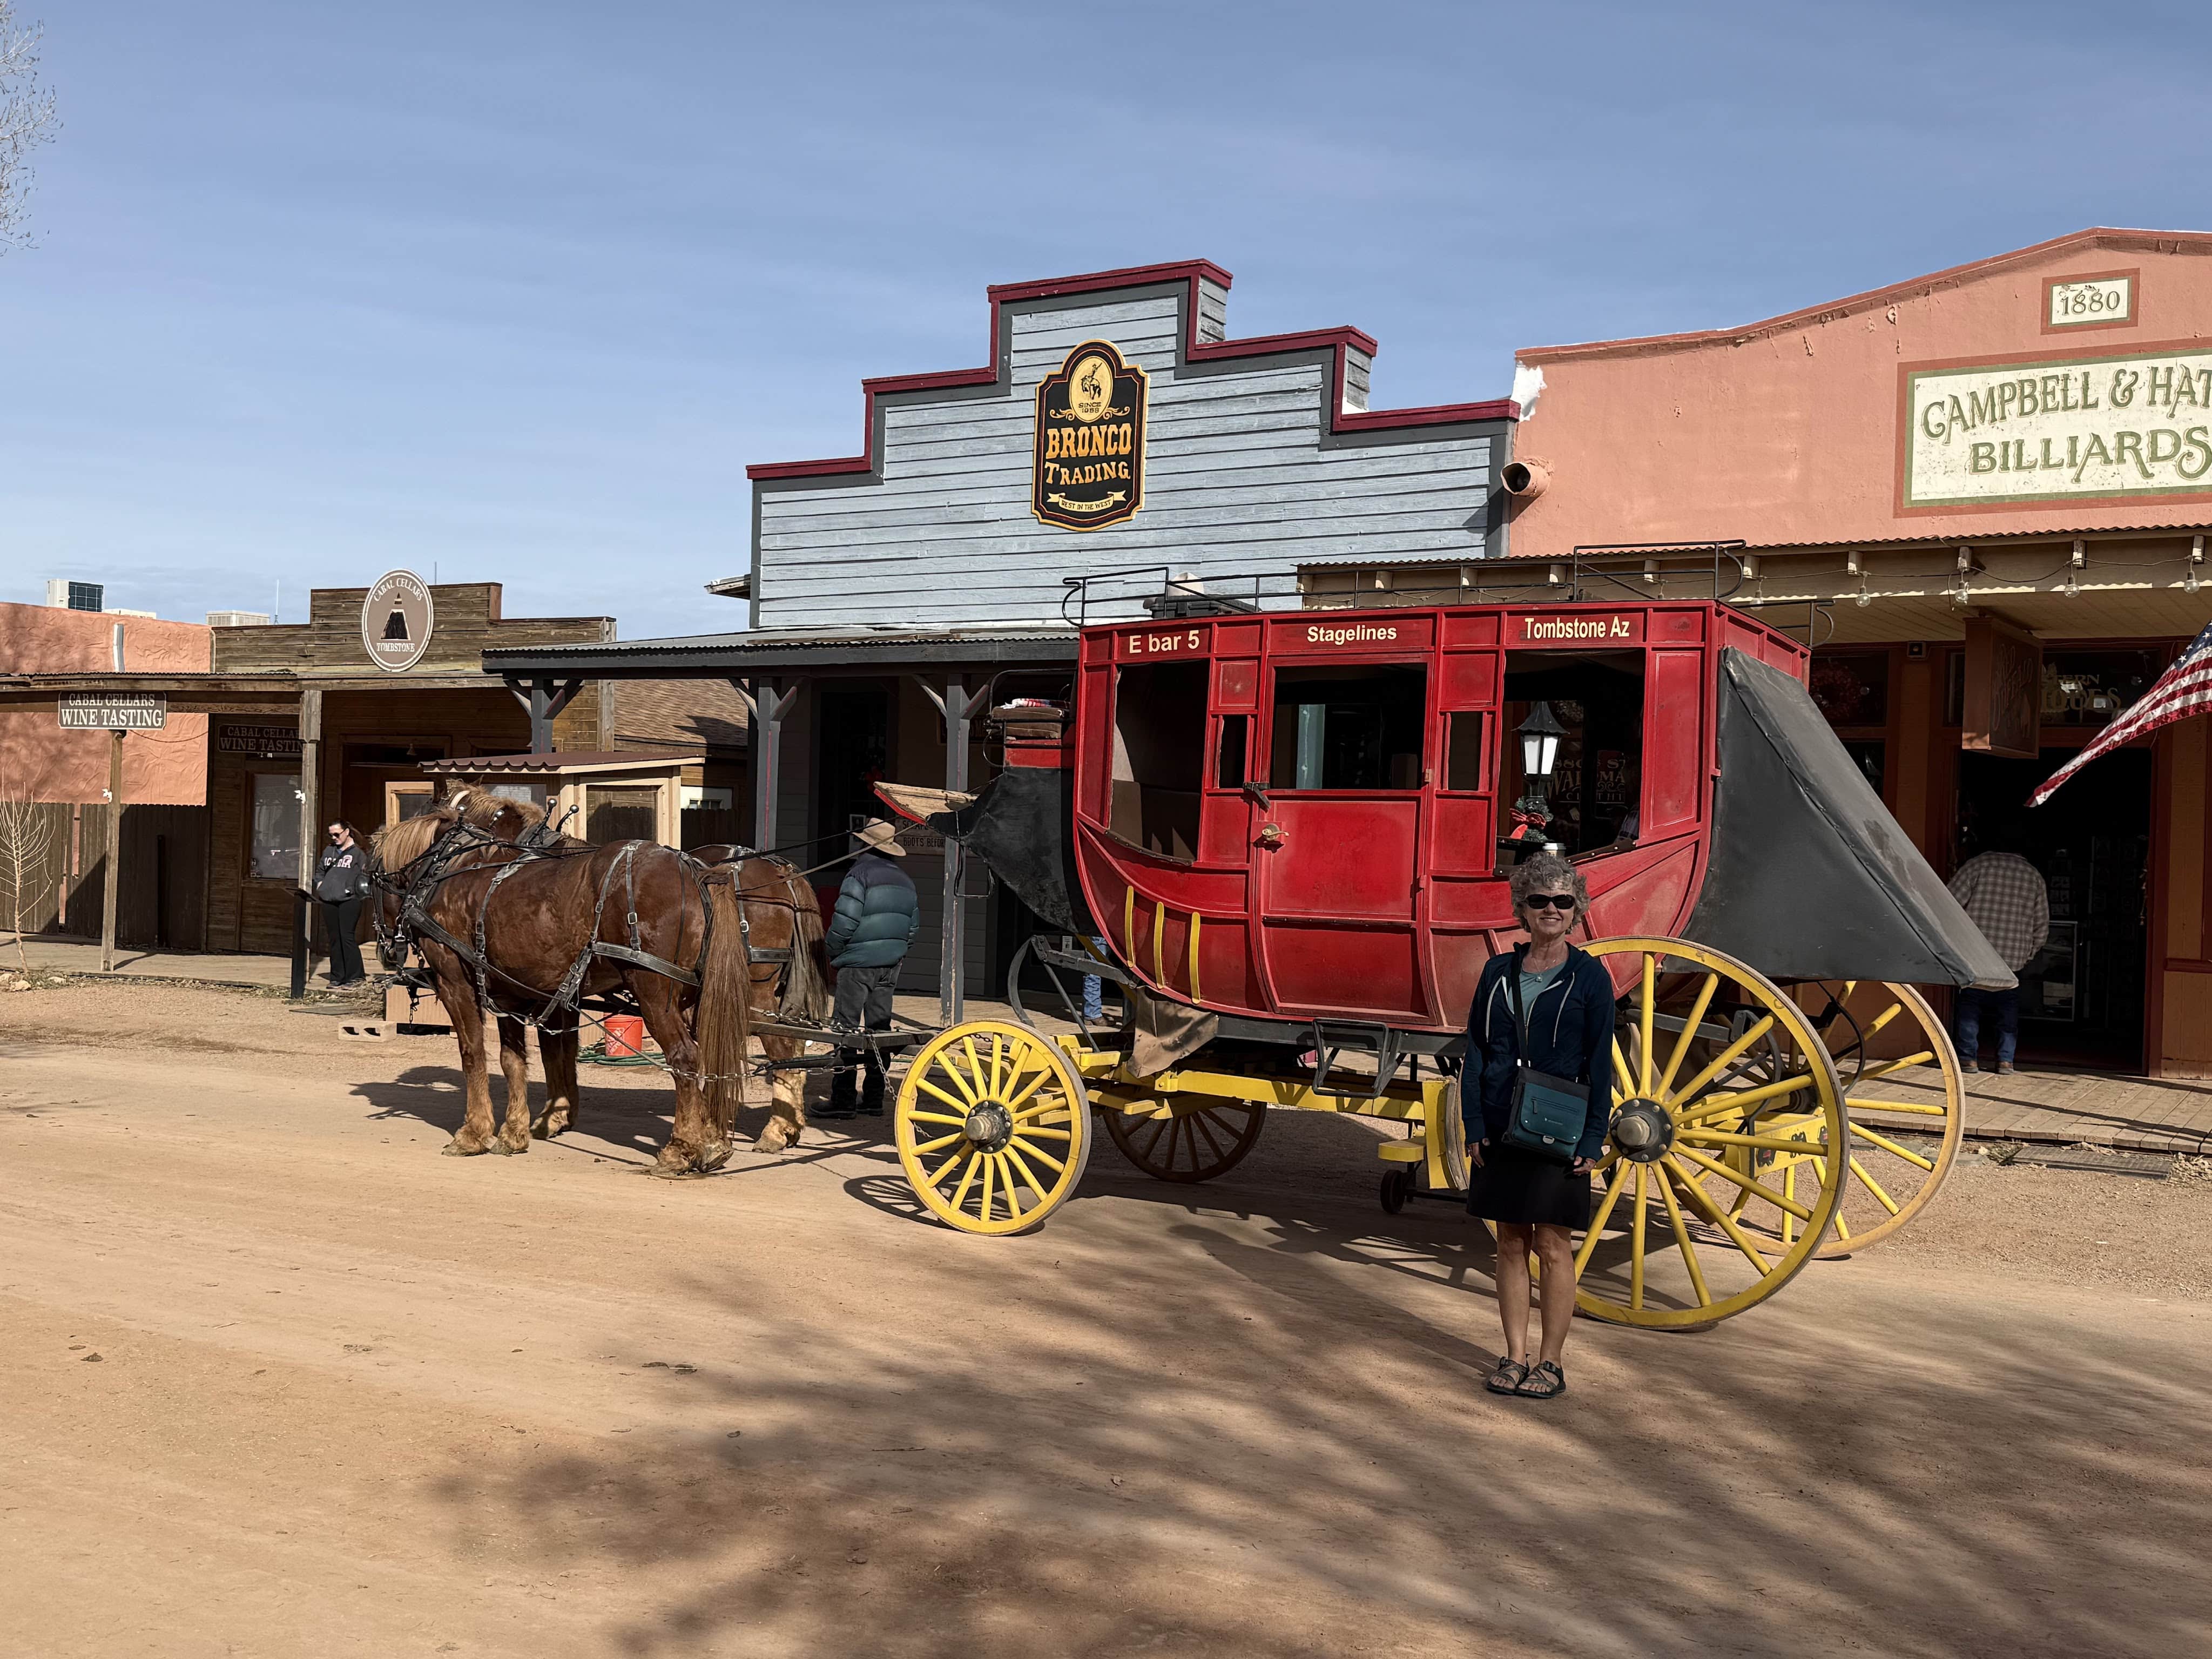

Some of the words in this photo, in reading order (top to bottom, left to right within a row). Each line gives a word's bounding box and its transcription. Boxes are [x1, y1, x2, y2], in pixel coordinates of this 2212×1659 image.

[2061, 290, 2121, 316] 1880
[1921, 371, 2099, 446] CAMPBELL
[2109, 368, 2139, 407] &
[1046, 423, 1132, 459] BRONCO
[1969, 424, 2212, 484] BILLIARDS
[1044, 461, 1131, 485] TRADING
[1095, 499, 1111, 509] WEST
[374, 579, 395, 602] CABAL
[396, 577, 424, 601] CELLARS
[1306, 624, 1398, 646] Stagelines
[1525, 616, 1607, 639] Tombstone
[1609, 615, 1630, 638] Az
[376, 642, 415, 652] TOMBSTONE
[1129, 635, 1142, 654] E
[1148, 633, 1182, 652] bar
[1188, 630, 1201, 649] 5
[69, 693, 103, 706] CABAL
[105, 693, 155, 707] CELLARS
[61, 709, 98, 725] WINE
[101, 709, 163, 727] TASTING
[227, 726, 261, 737] CABAL
[220, 737, 256, 750] WINE
[259, 739, 303, 752] TASTIN
[903, 837, 924, 847] BOOTS
[927, 838, 945, 847] BEFOR
